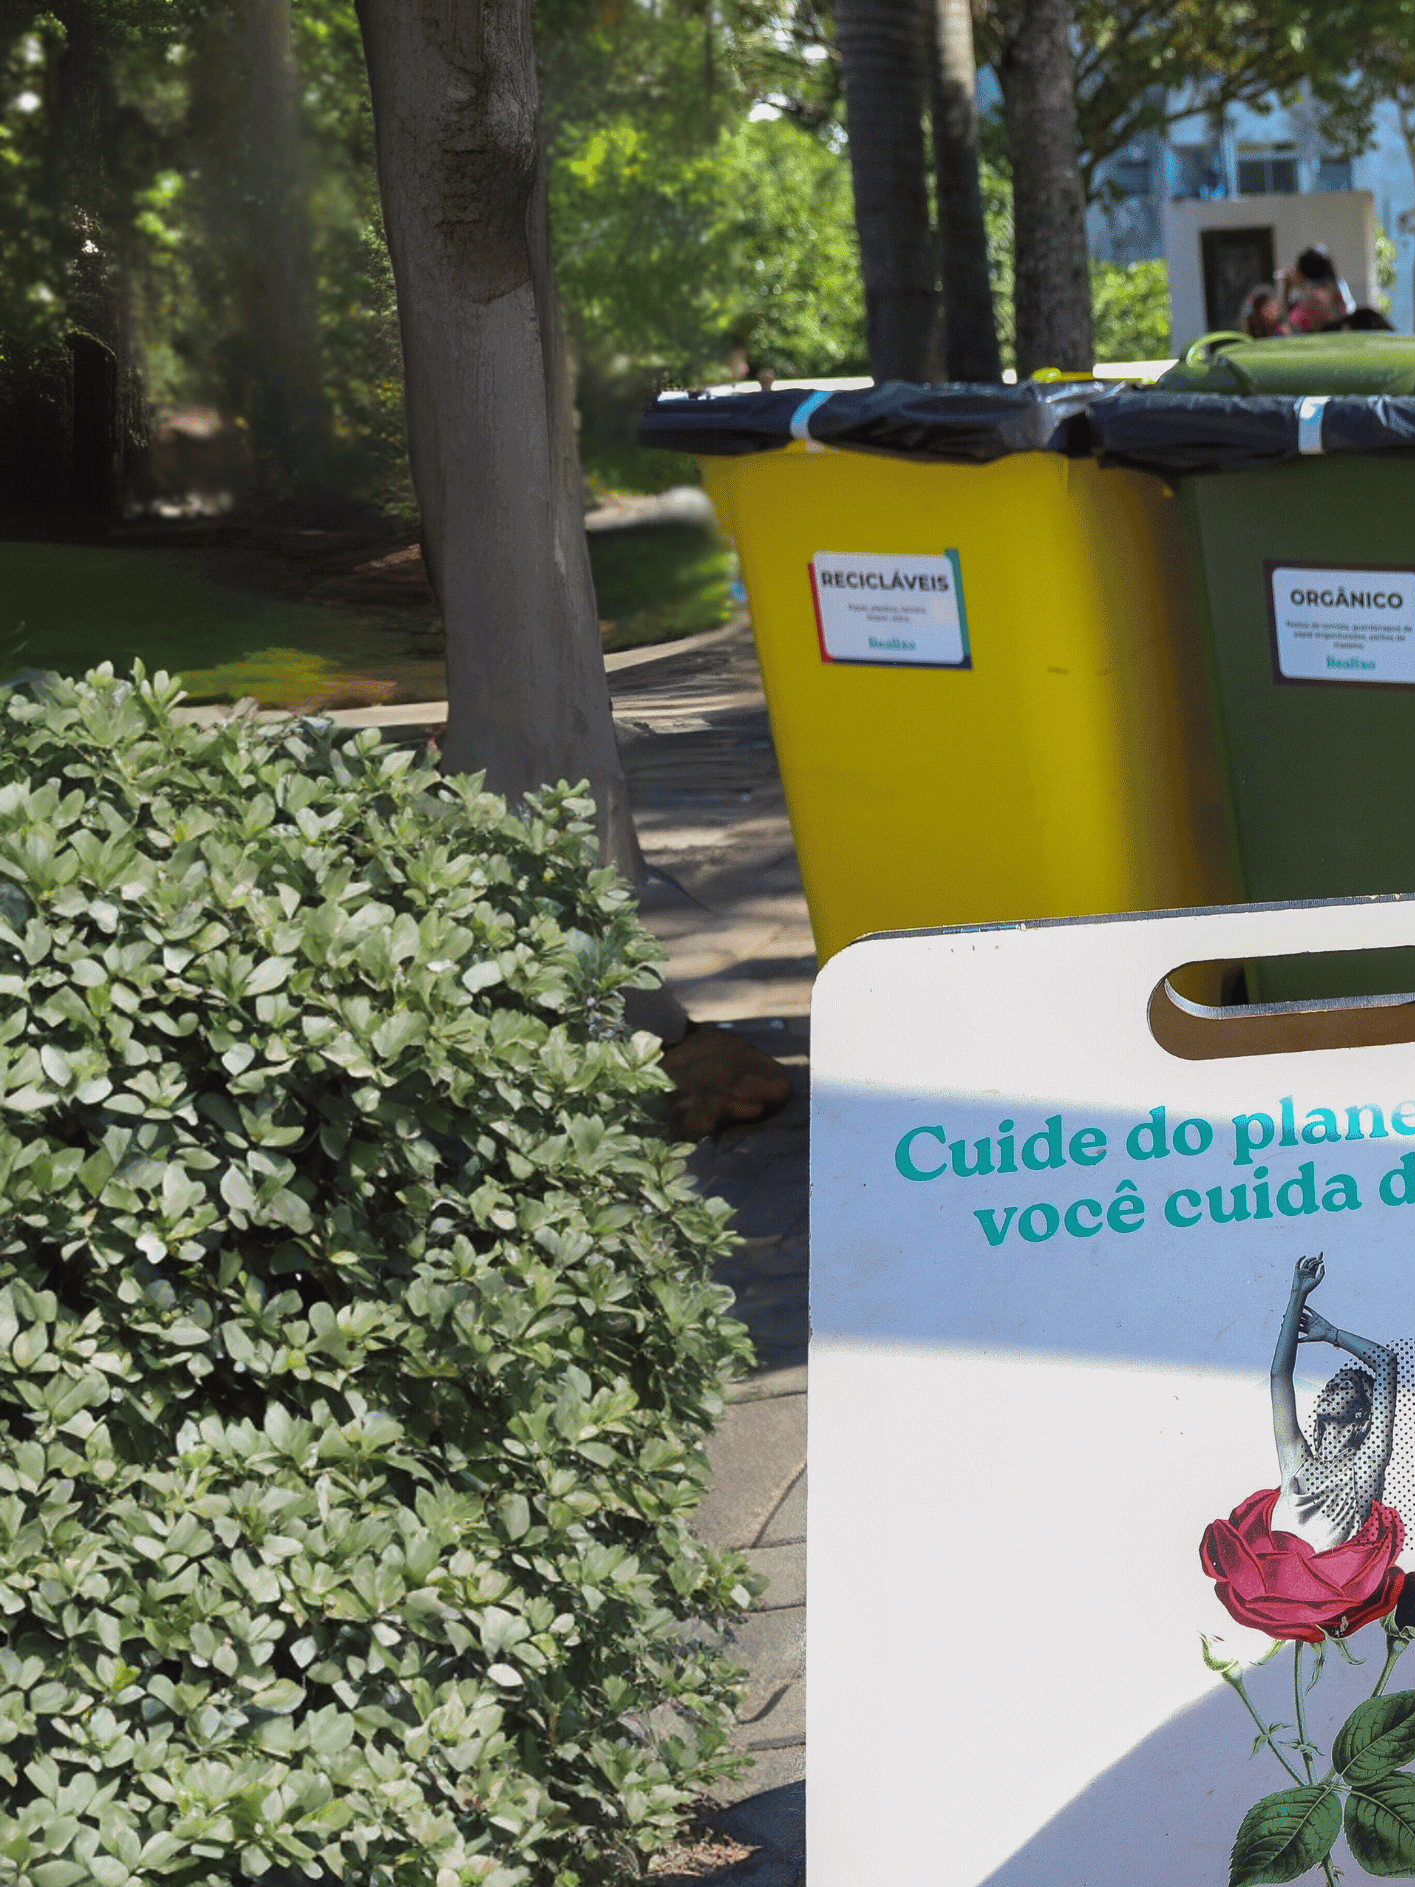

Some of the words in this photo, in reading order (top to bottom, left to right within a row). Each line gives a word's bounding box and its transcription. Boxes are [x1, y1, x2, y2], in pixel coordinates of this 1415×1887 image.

[821, 569, 949, 593] RECICLÁVEIS
[1290, 585, 1403, 609] ORGÂNICO
[894, 1118, 1107, 1182] Cuide
[1125, 1105, 1214, 1161] do
[975, 1181, 1145, 1247] você
[1163, 1161, 1361, 1229] cuida
